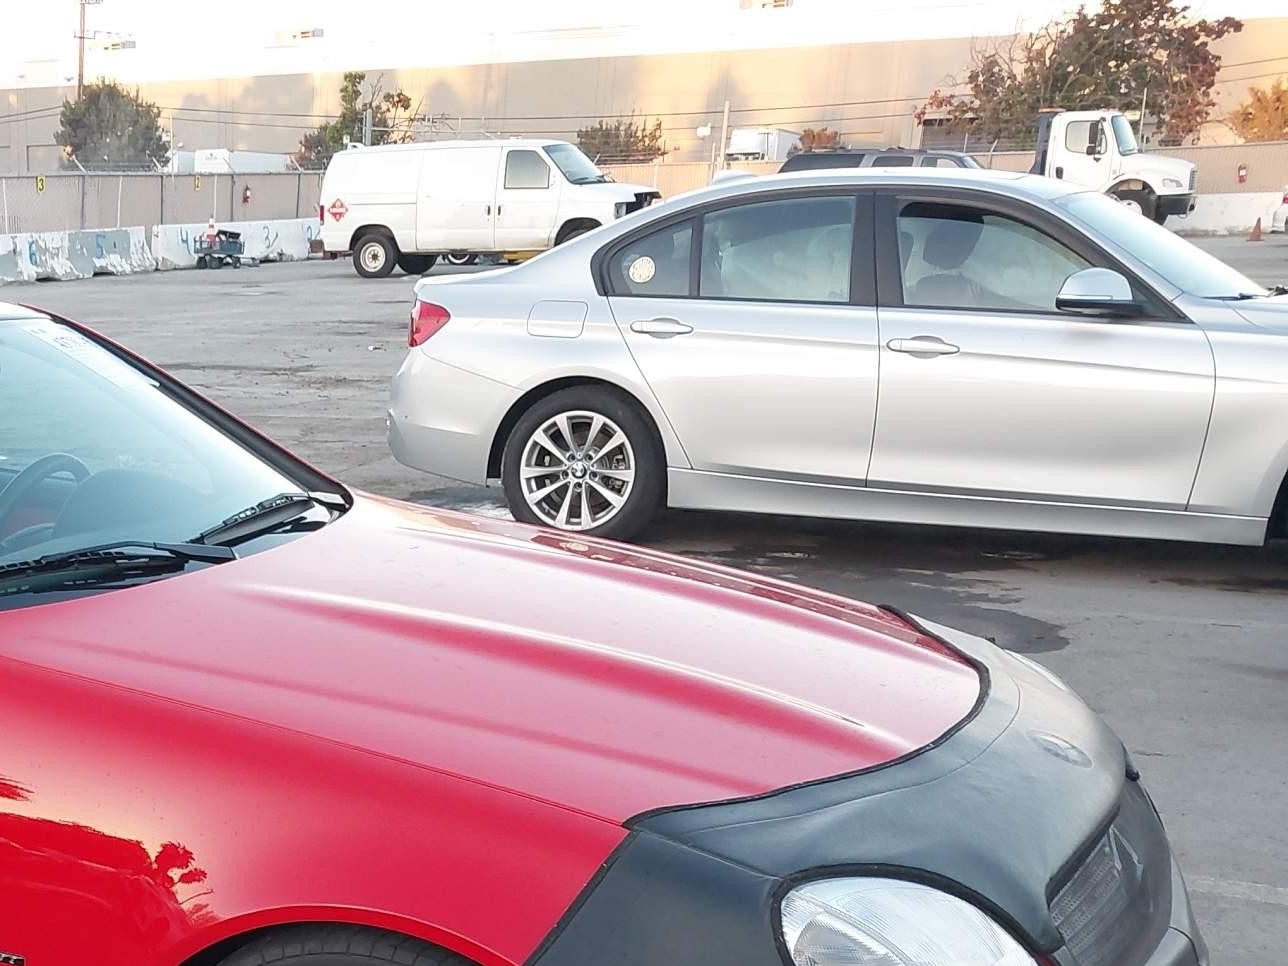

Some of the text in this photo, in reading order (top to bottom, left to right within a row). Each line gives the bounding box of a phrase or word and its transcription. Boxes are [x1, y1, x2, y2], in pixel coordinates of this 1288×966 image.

[38, 178, 44, 192] 3
[28, 239, 38, 266] 6
[95, 234, 105, 259] 5
[179, 226, 191, 256] 4
